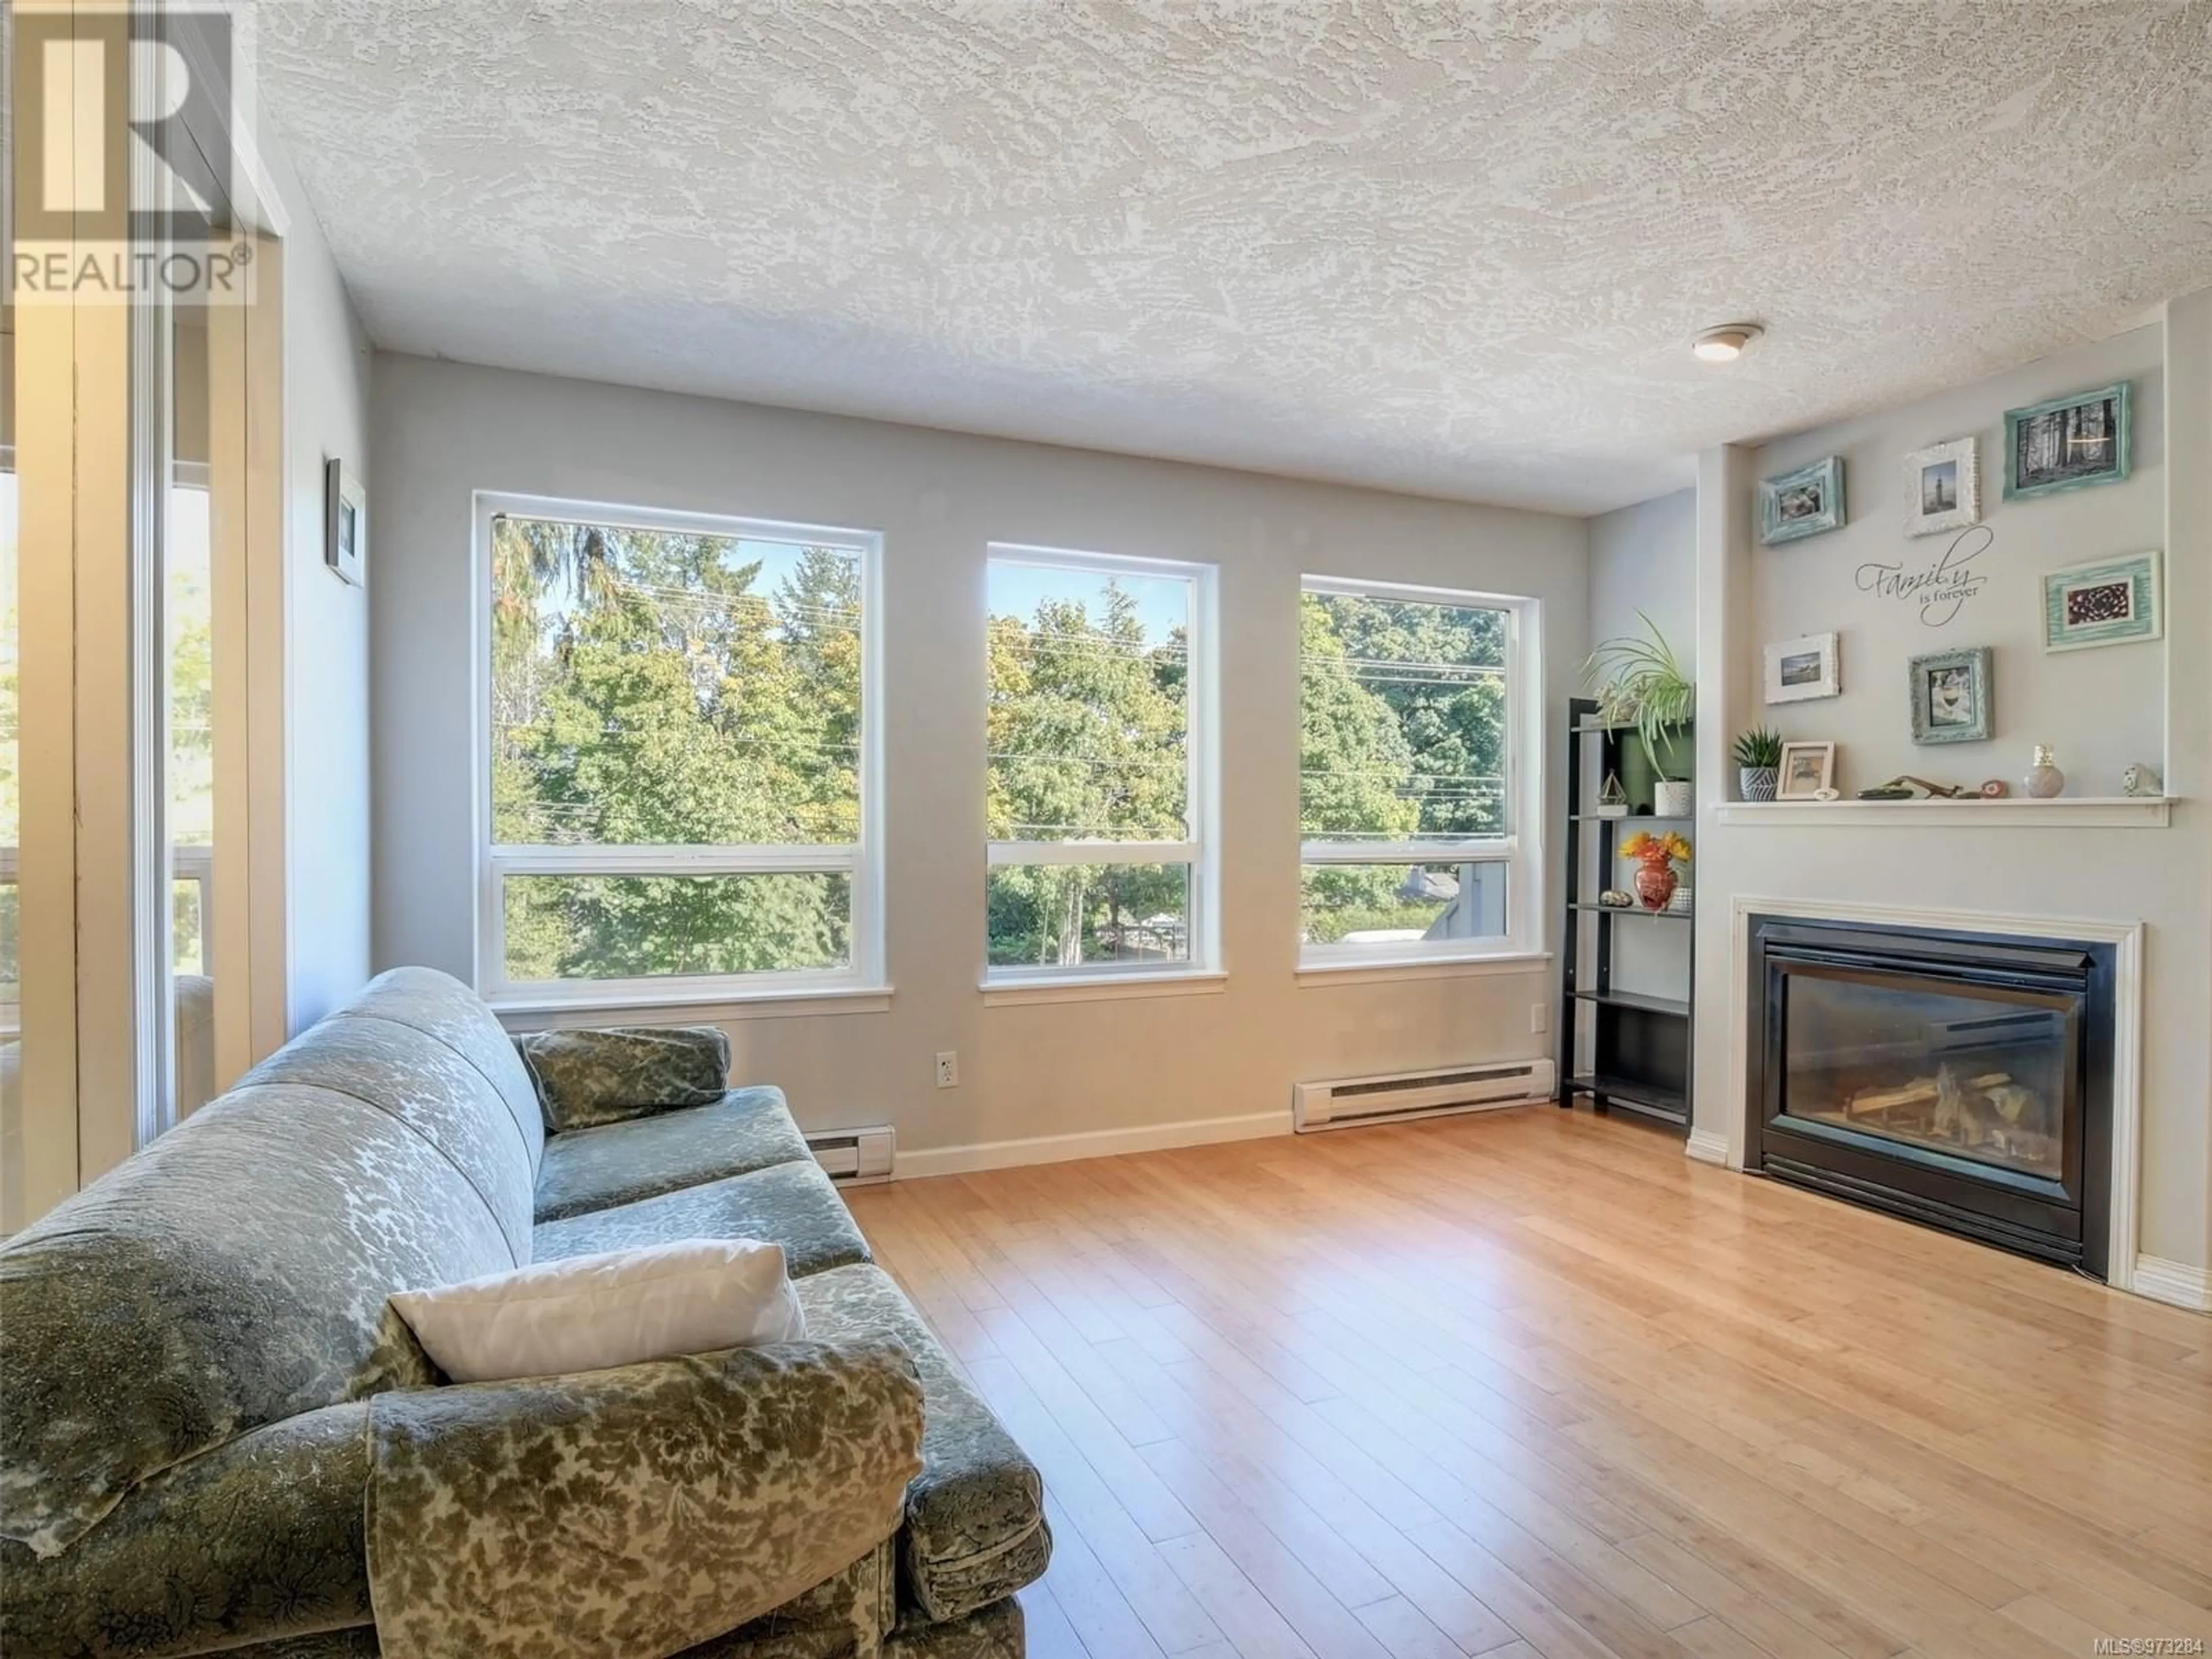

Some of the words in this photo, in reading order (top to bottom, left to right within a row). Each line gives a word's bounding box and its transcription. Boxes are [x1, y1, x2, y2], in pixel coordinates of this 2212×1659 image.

[1855, 525, 1994, 627] Family
[1919, 593, 1931, 605] is
[1933, 586, 1979, 603] forever
